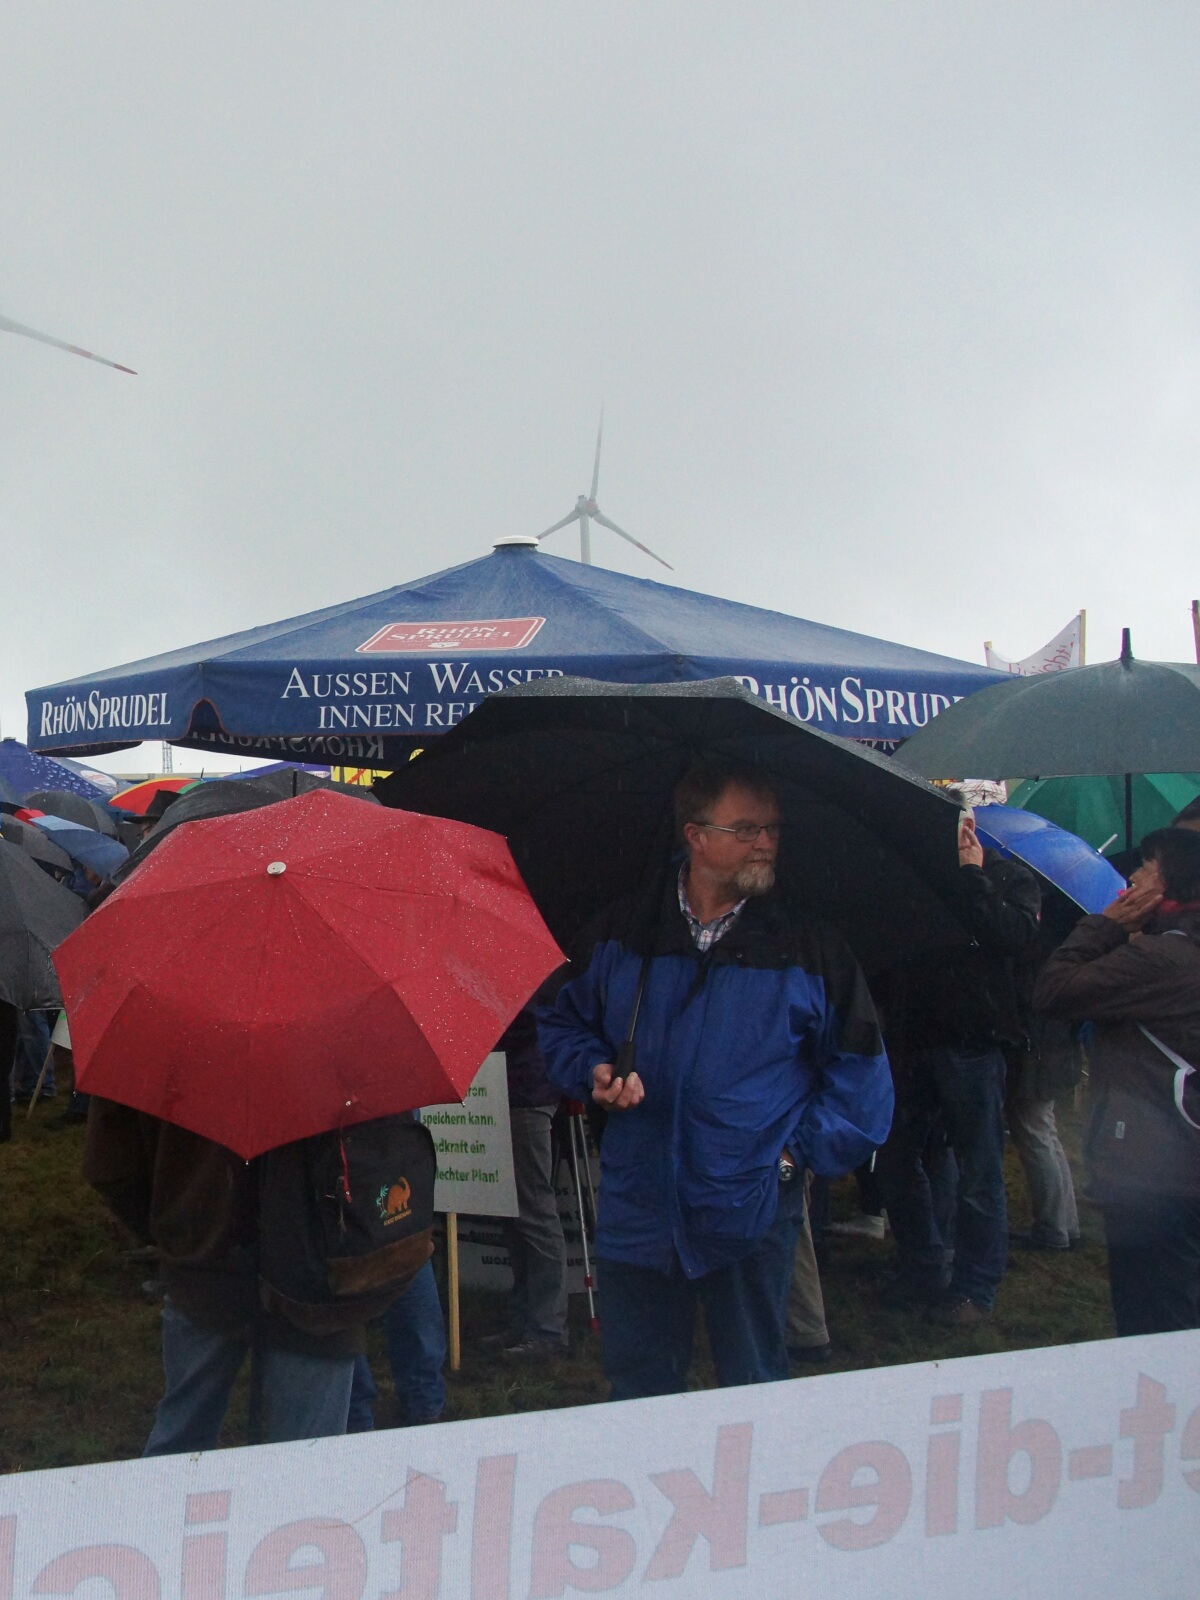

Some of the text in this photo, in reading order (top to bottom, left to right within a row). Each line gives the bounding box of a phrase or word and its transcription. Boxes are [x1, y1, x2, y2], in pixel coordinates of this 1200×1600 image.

[733, 675, 965, 728] HÖNSPRUD
[317, 702, 417, 729] INNEN
[423, 1112, 497, 1128] speichern kann,
[435, 1138, 486, 1154] ndkraft ein
[436, 1166, 499, 1183] lechter Plan!
